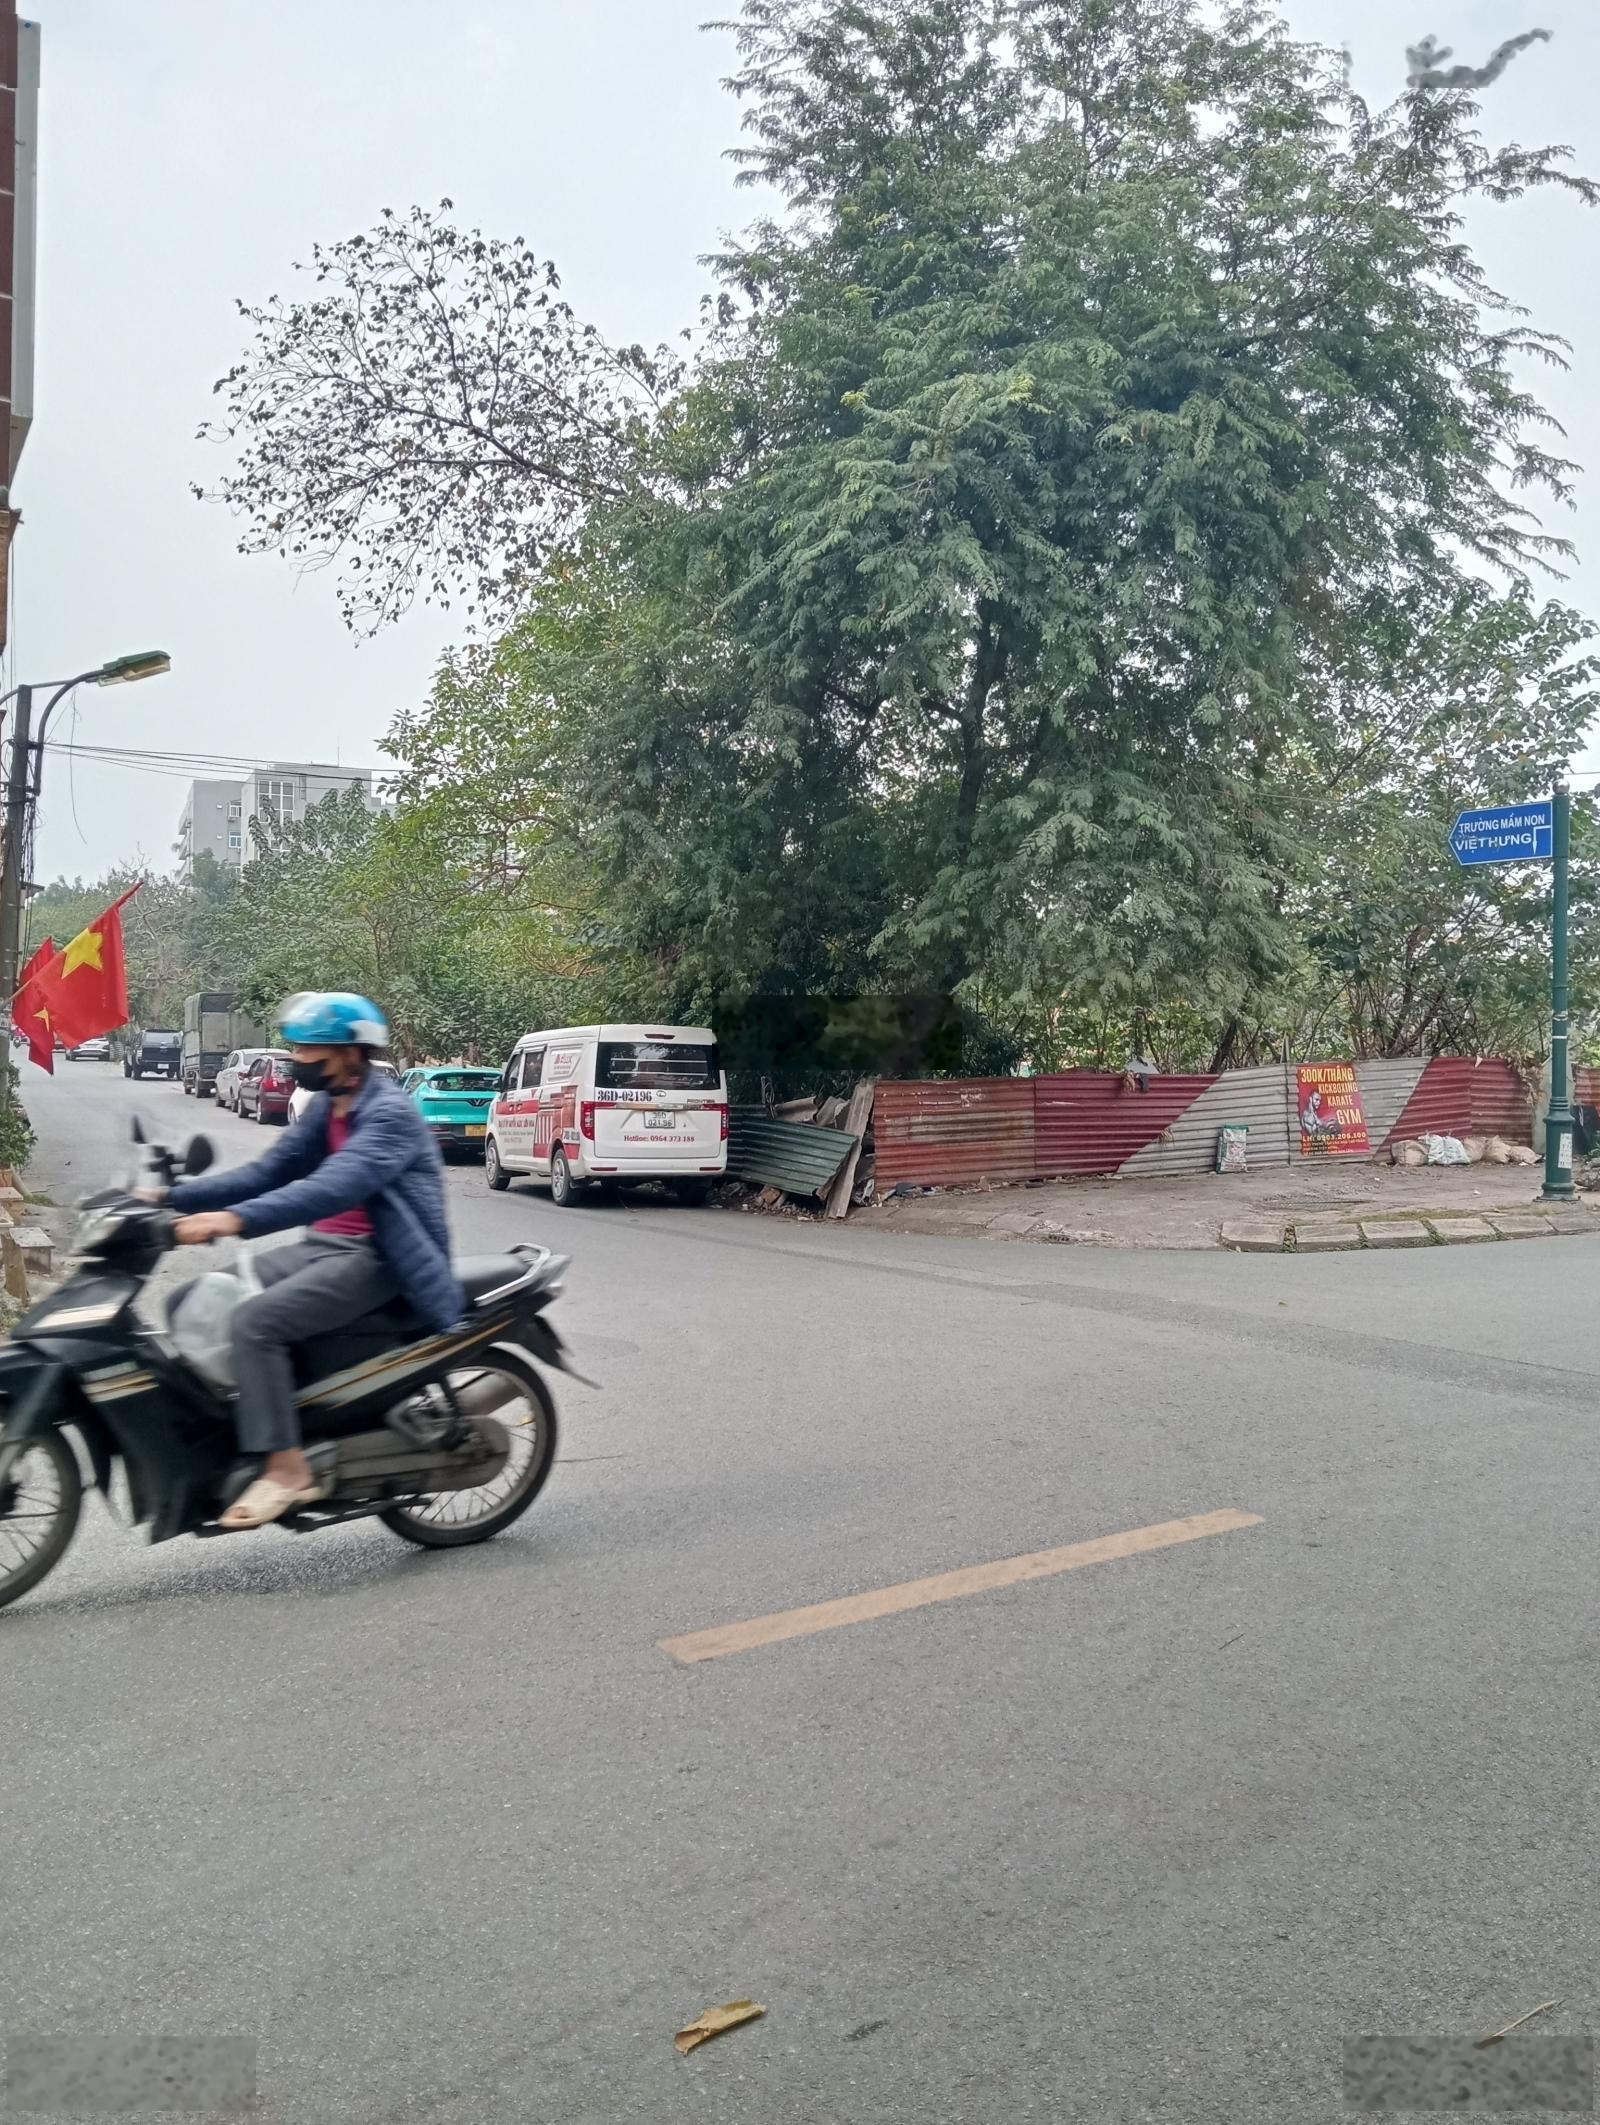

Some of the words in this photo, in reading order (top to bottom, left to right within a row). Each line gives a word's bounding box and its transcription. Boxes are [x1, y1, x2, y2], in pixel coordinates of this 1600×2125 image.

[1459, 817, 1500, 833] TRƯỜNG
[1524, 814, 1545, 826] NON
[1455, 835, 1489, 853] VIỆT
[1489, 833, 1532, 847] HƯNG
[597, 1089, 653, 1102] 36D-02196
[1318, 1082, 1358, 1094] KICKBOXING
[1327, 1095, 1354, 1107] KARATE
[1336, 1108, 1362, 1125] GYM
